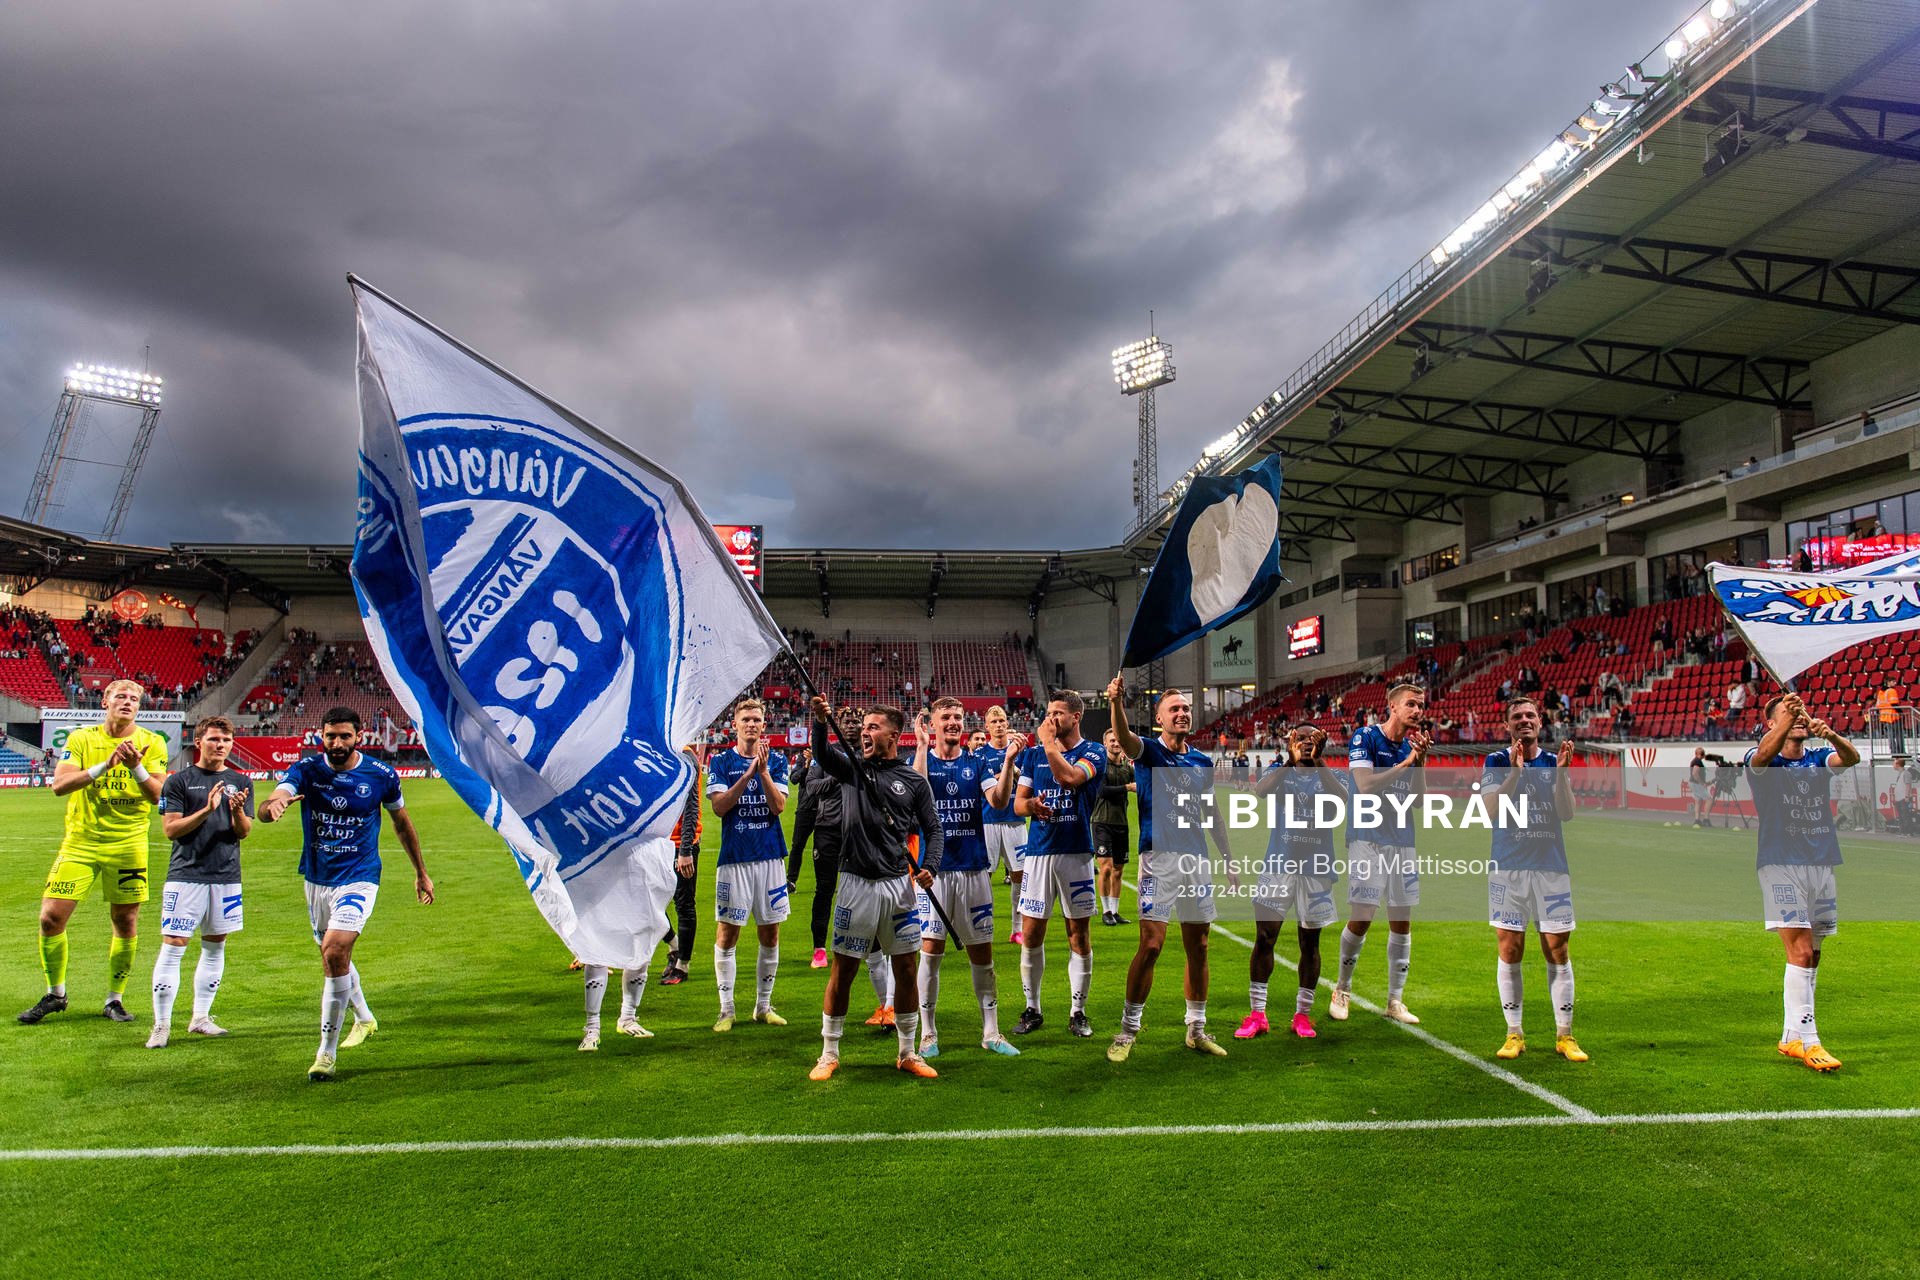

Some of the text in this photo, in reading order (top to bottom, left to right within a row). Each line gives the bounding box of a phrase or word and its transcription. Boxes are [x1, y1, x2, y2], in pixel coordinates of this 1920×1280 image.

[737, 794, 767, 804] ELLB
[738, 805, 770, 817] GÅRD
[311, 810, 364, 827] MELLBY
[316, 825, 355, 840] GÅRD
[1024, 905, 1044, 913] SPORT
